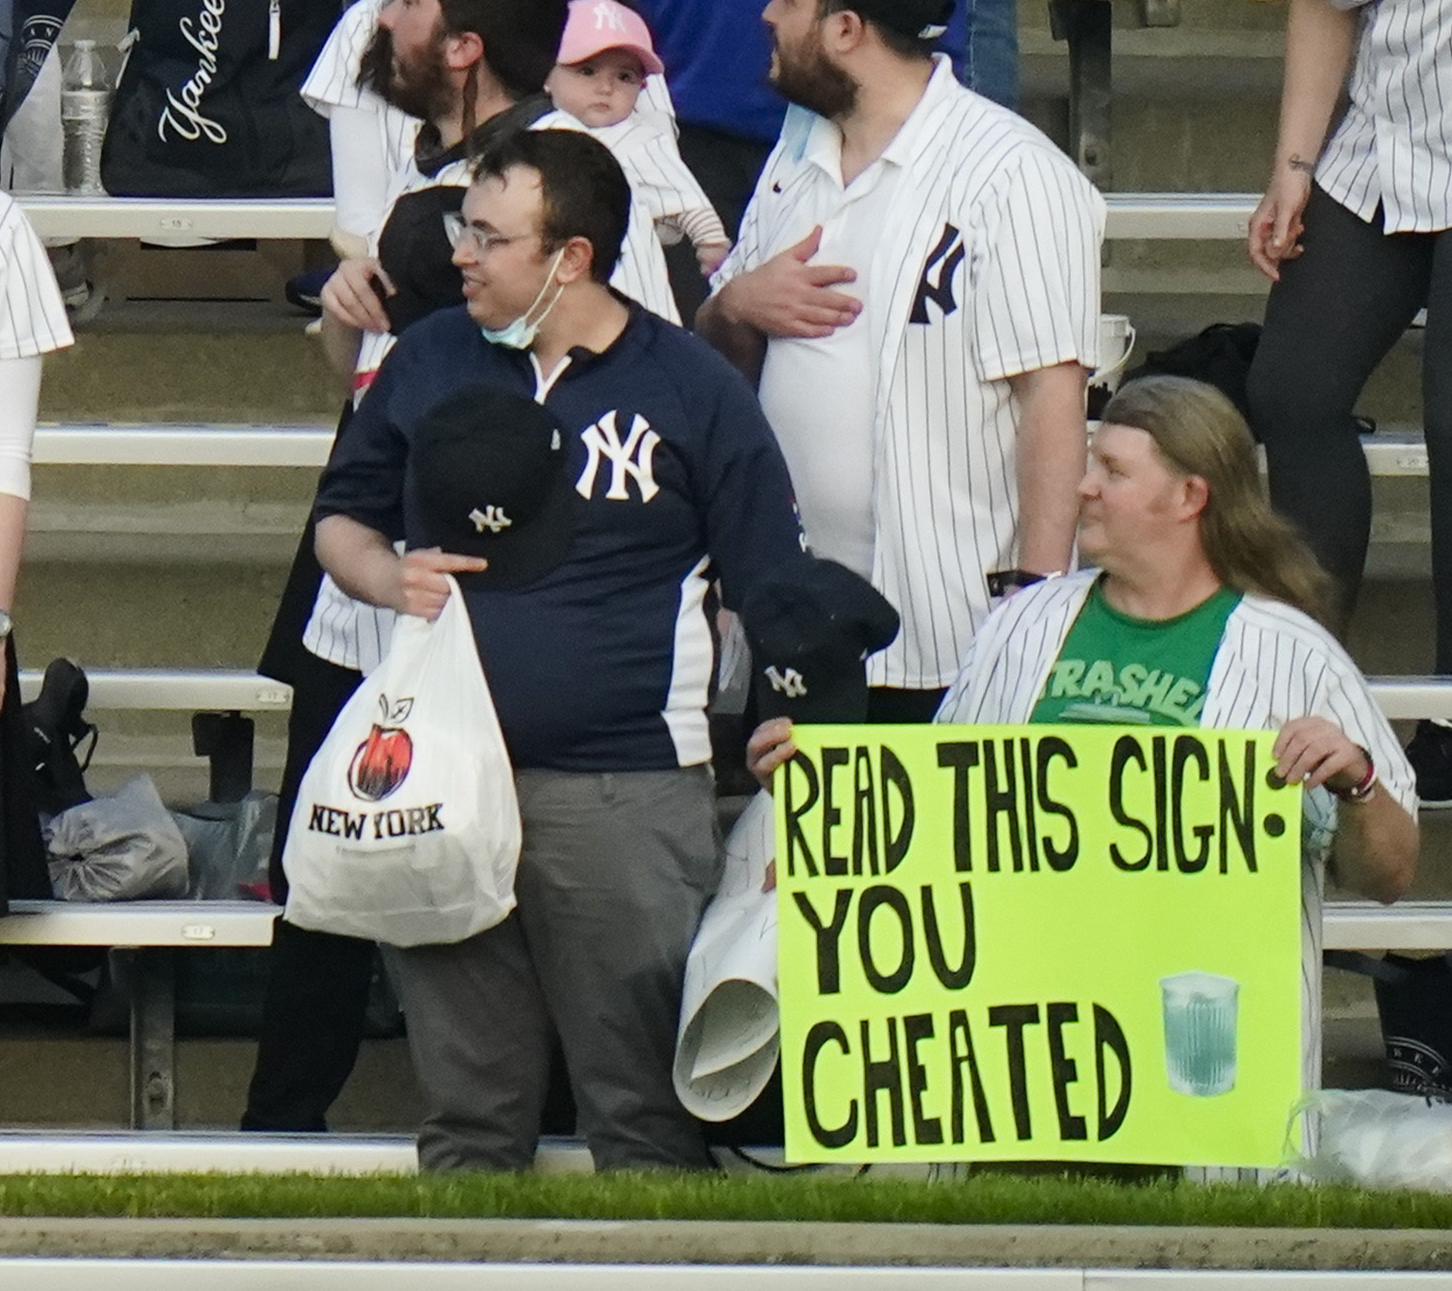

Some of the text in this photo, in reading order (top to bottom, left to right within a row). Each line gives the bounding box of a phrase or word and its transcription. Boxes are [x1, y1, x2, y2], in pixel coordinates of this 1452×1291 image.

[575, 409, 661, 505] NY
[308, 802, 445, 841] NEW YORK
[784, 734, 1286, 877] READ THIS SIGN:
[792, 881, 977, 996] YOU
[801, 1002, 1132, 1149] CHEATED
